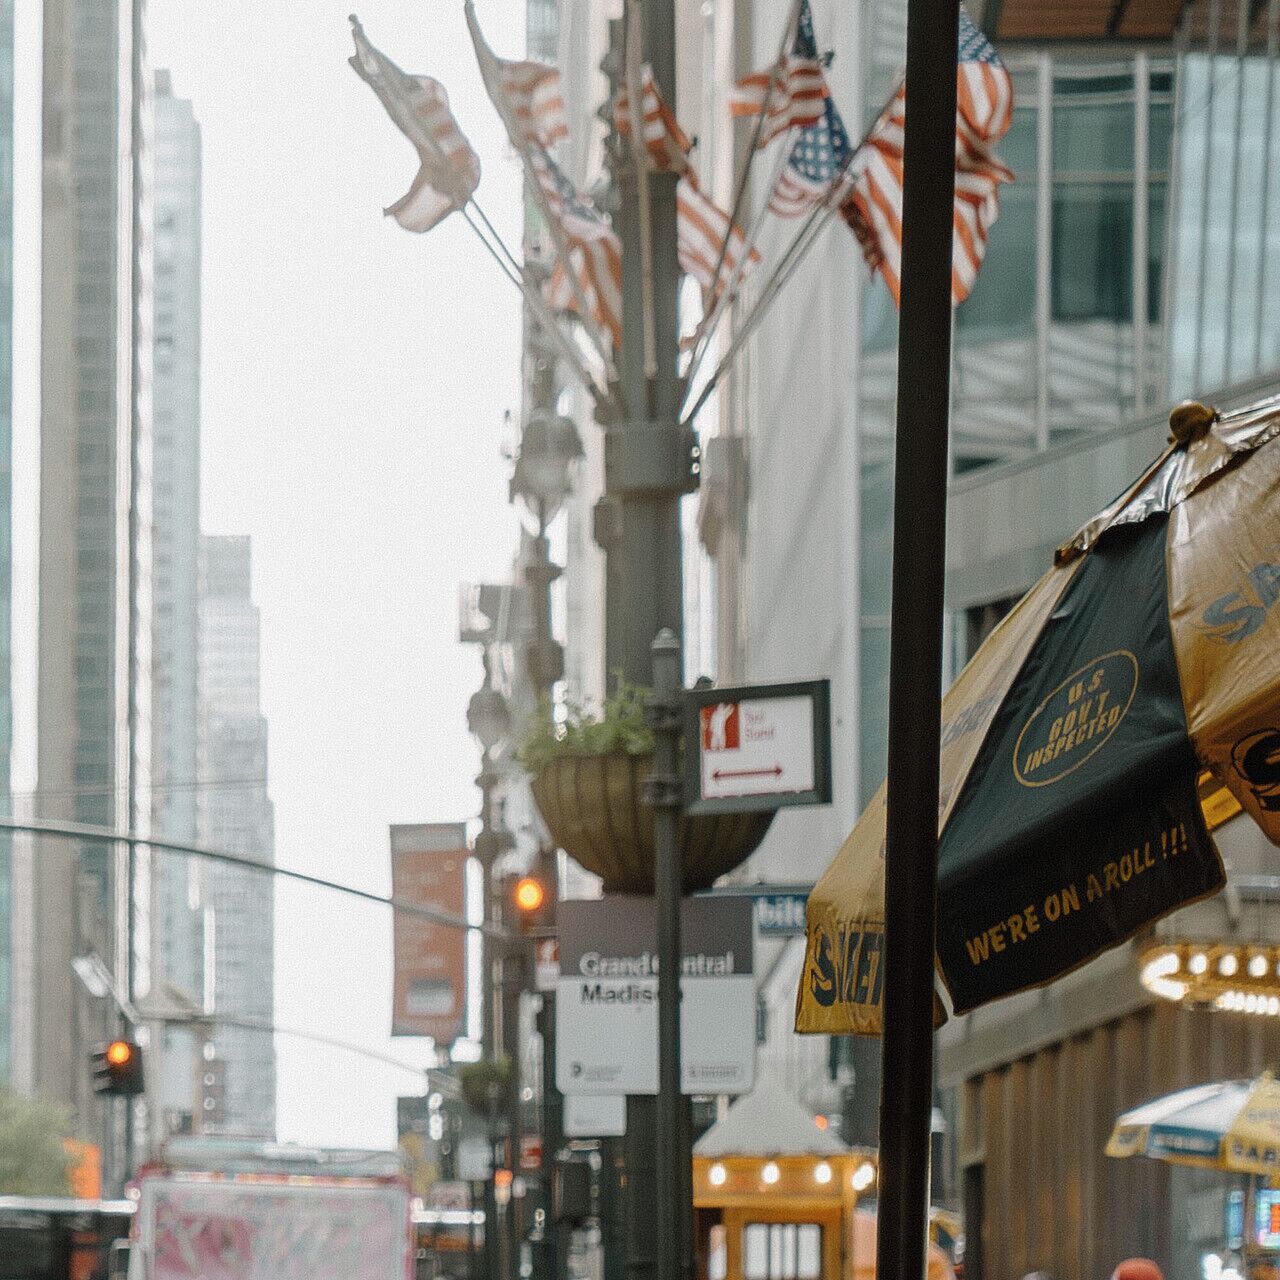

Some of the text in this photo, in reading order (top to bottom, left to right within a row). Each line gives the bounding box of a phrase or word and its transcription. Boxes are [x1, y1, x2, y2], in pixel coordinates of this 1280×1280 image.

[1023, 705, 1120, 775] INSPECTED
[965, 905, 1041, 966] WE'RE
[1044, 884, 1081, 922] ON
[1086, 873, 1103, 903] A
[1104, 842, 1156, 892] ROLL
[579, 951, 651, 977] Grand
